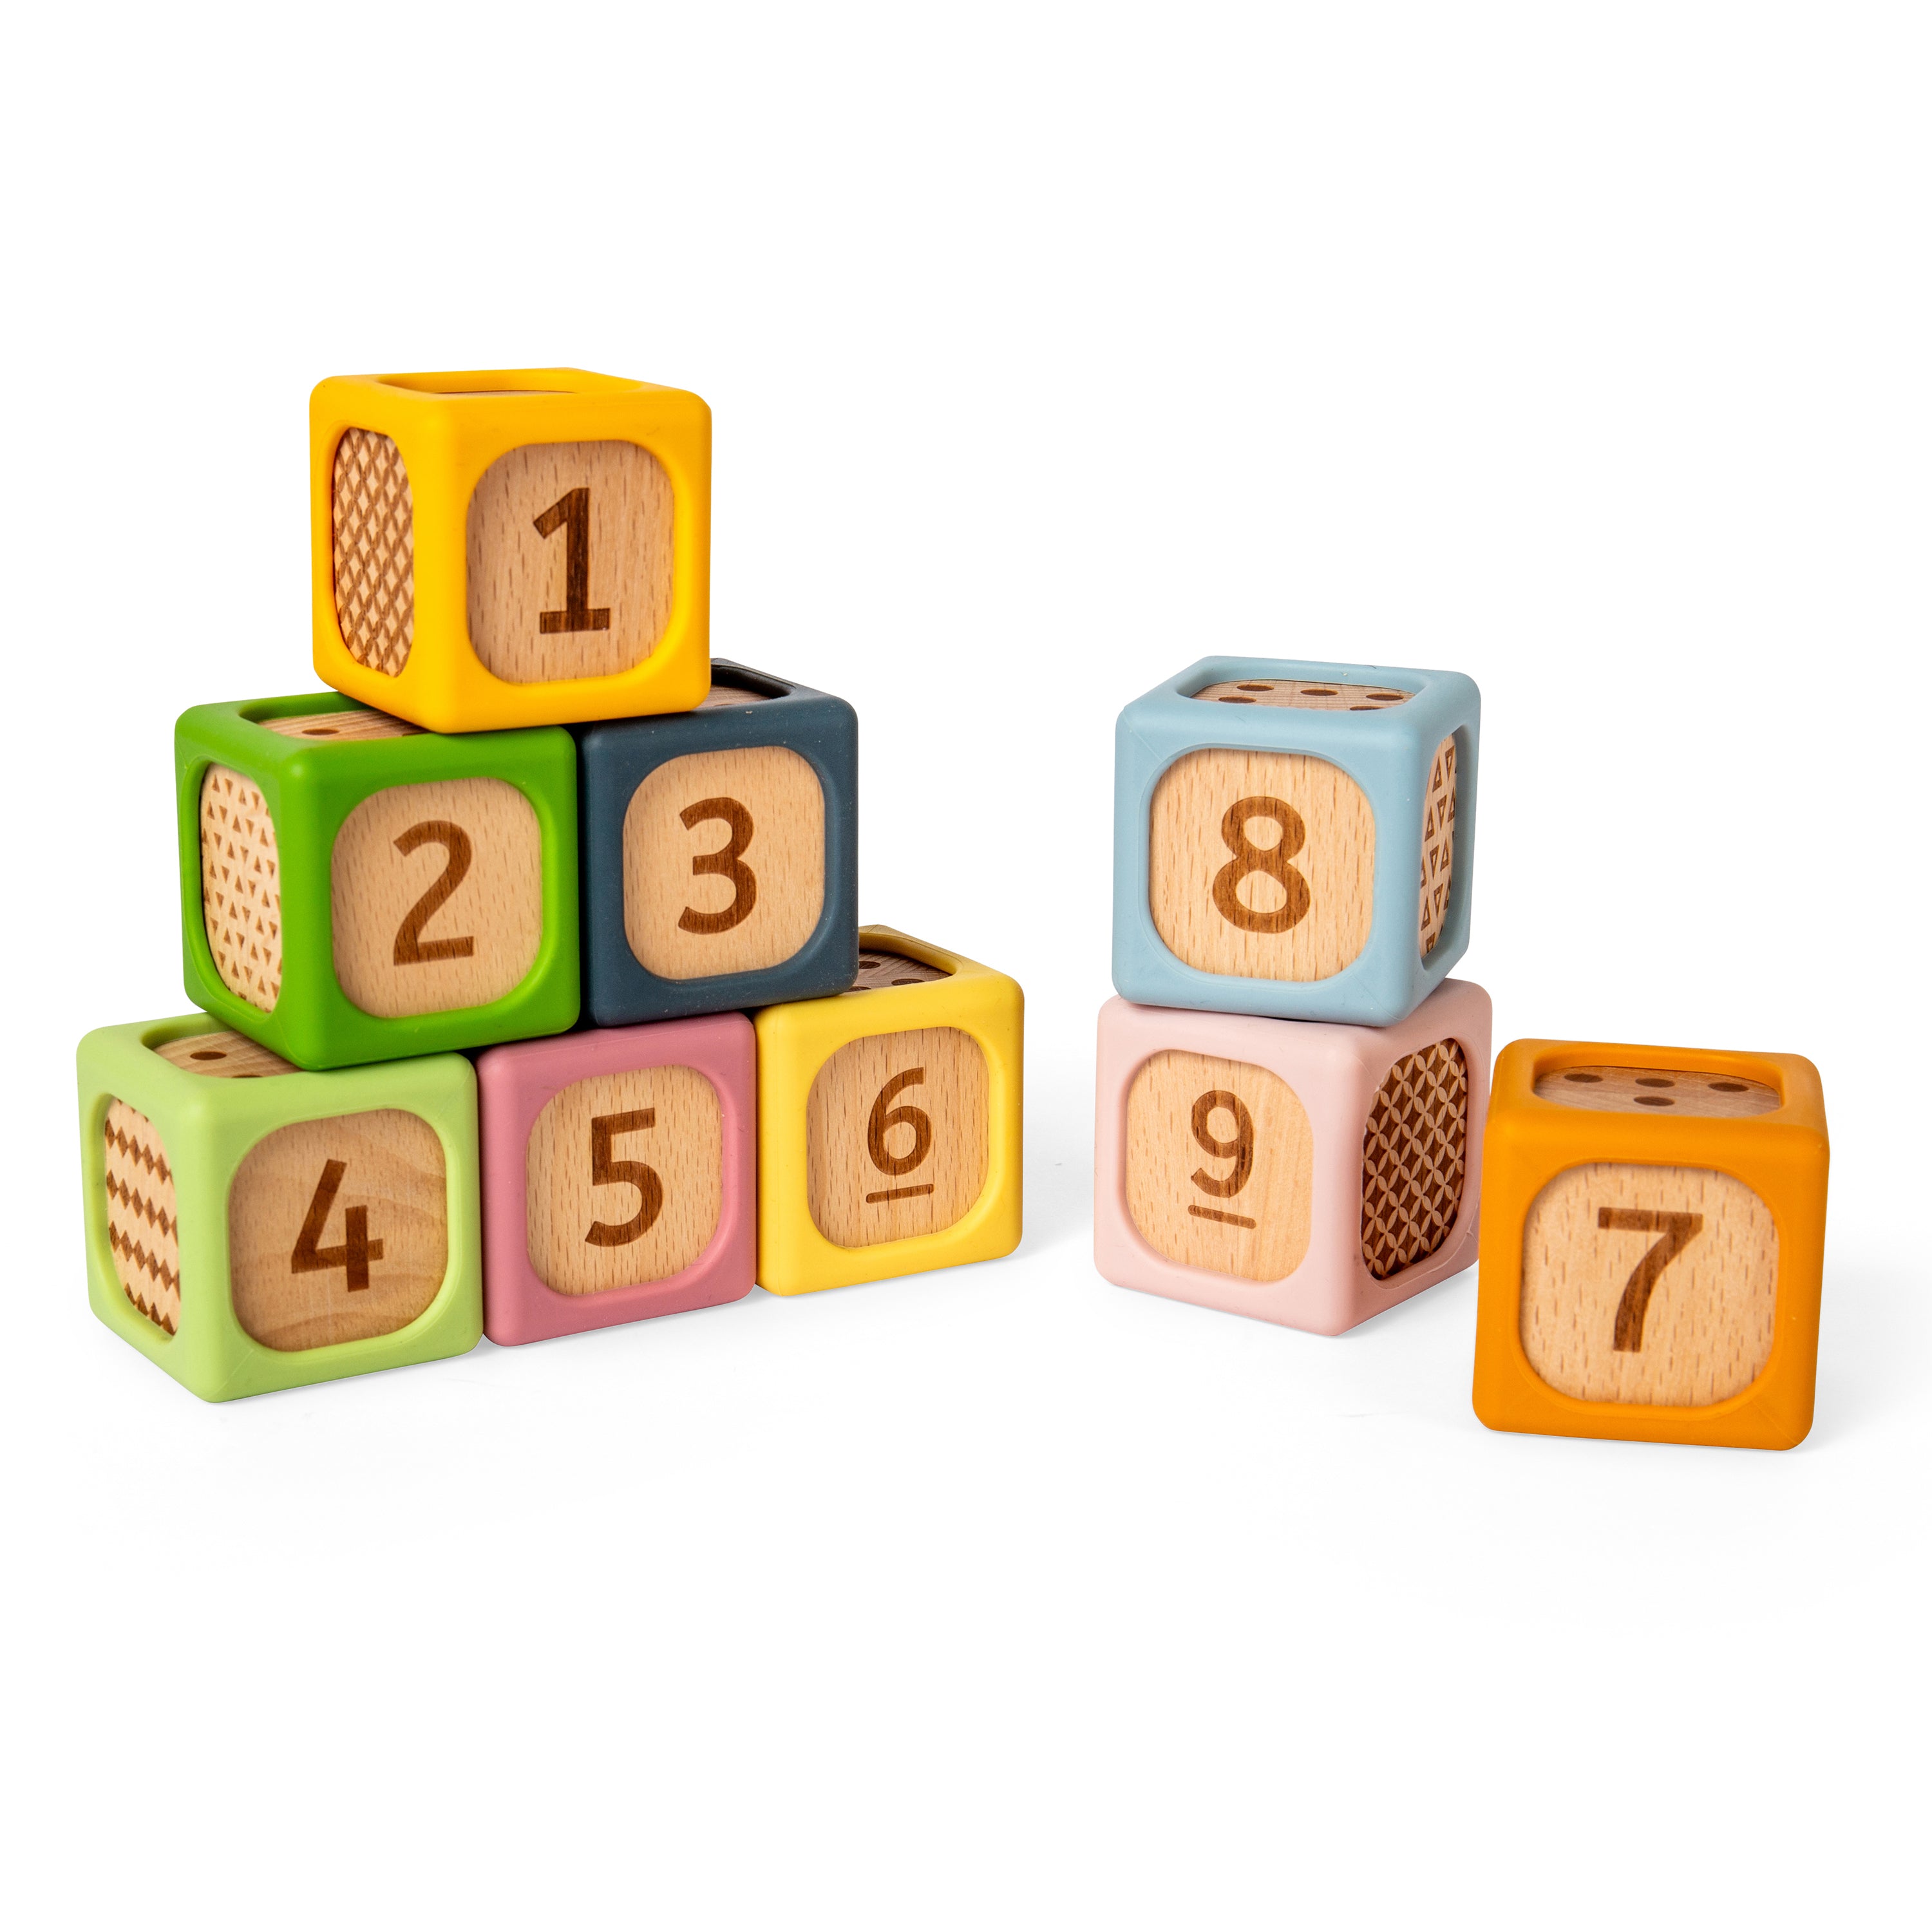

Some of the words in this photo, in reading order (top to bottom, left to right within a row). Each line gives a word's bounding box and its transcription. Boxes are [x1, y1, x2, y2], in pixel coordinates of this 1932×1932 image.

[533, 488, 610, 634] 1
[393, 820, 473, 966] 2
[677, 797, 757, 934] 3
[1213, 796, 1311, 934] 8
[584, 1107, 663, 1247] 5
[867, 1067, 932, 1176] 6
[1190, 1090, 1255, 1198] 9
[291, 1159, 384, 1293] 4
[1598, 1207, 1703, 1352] 7
